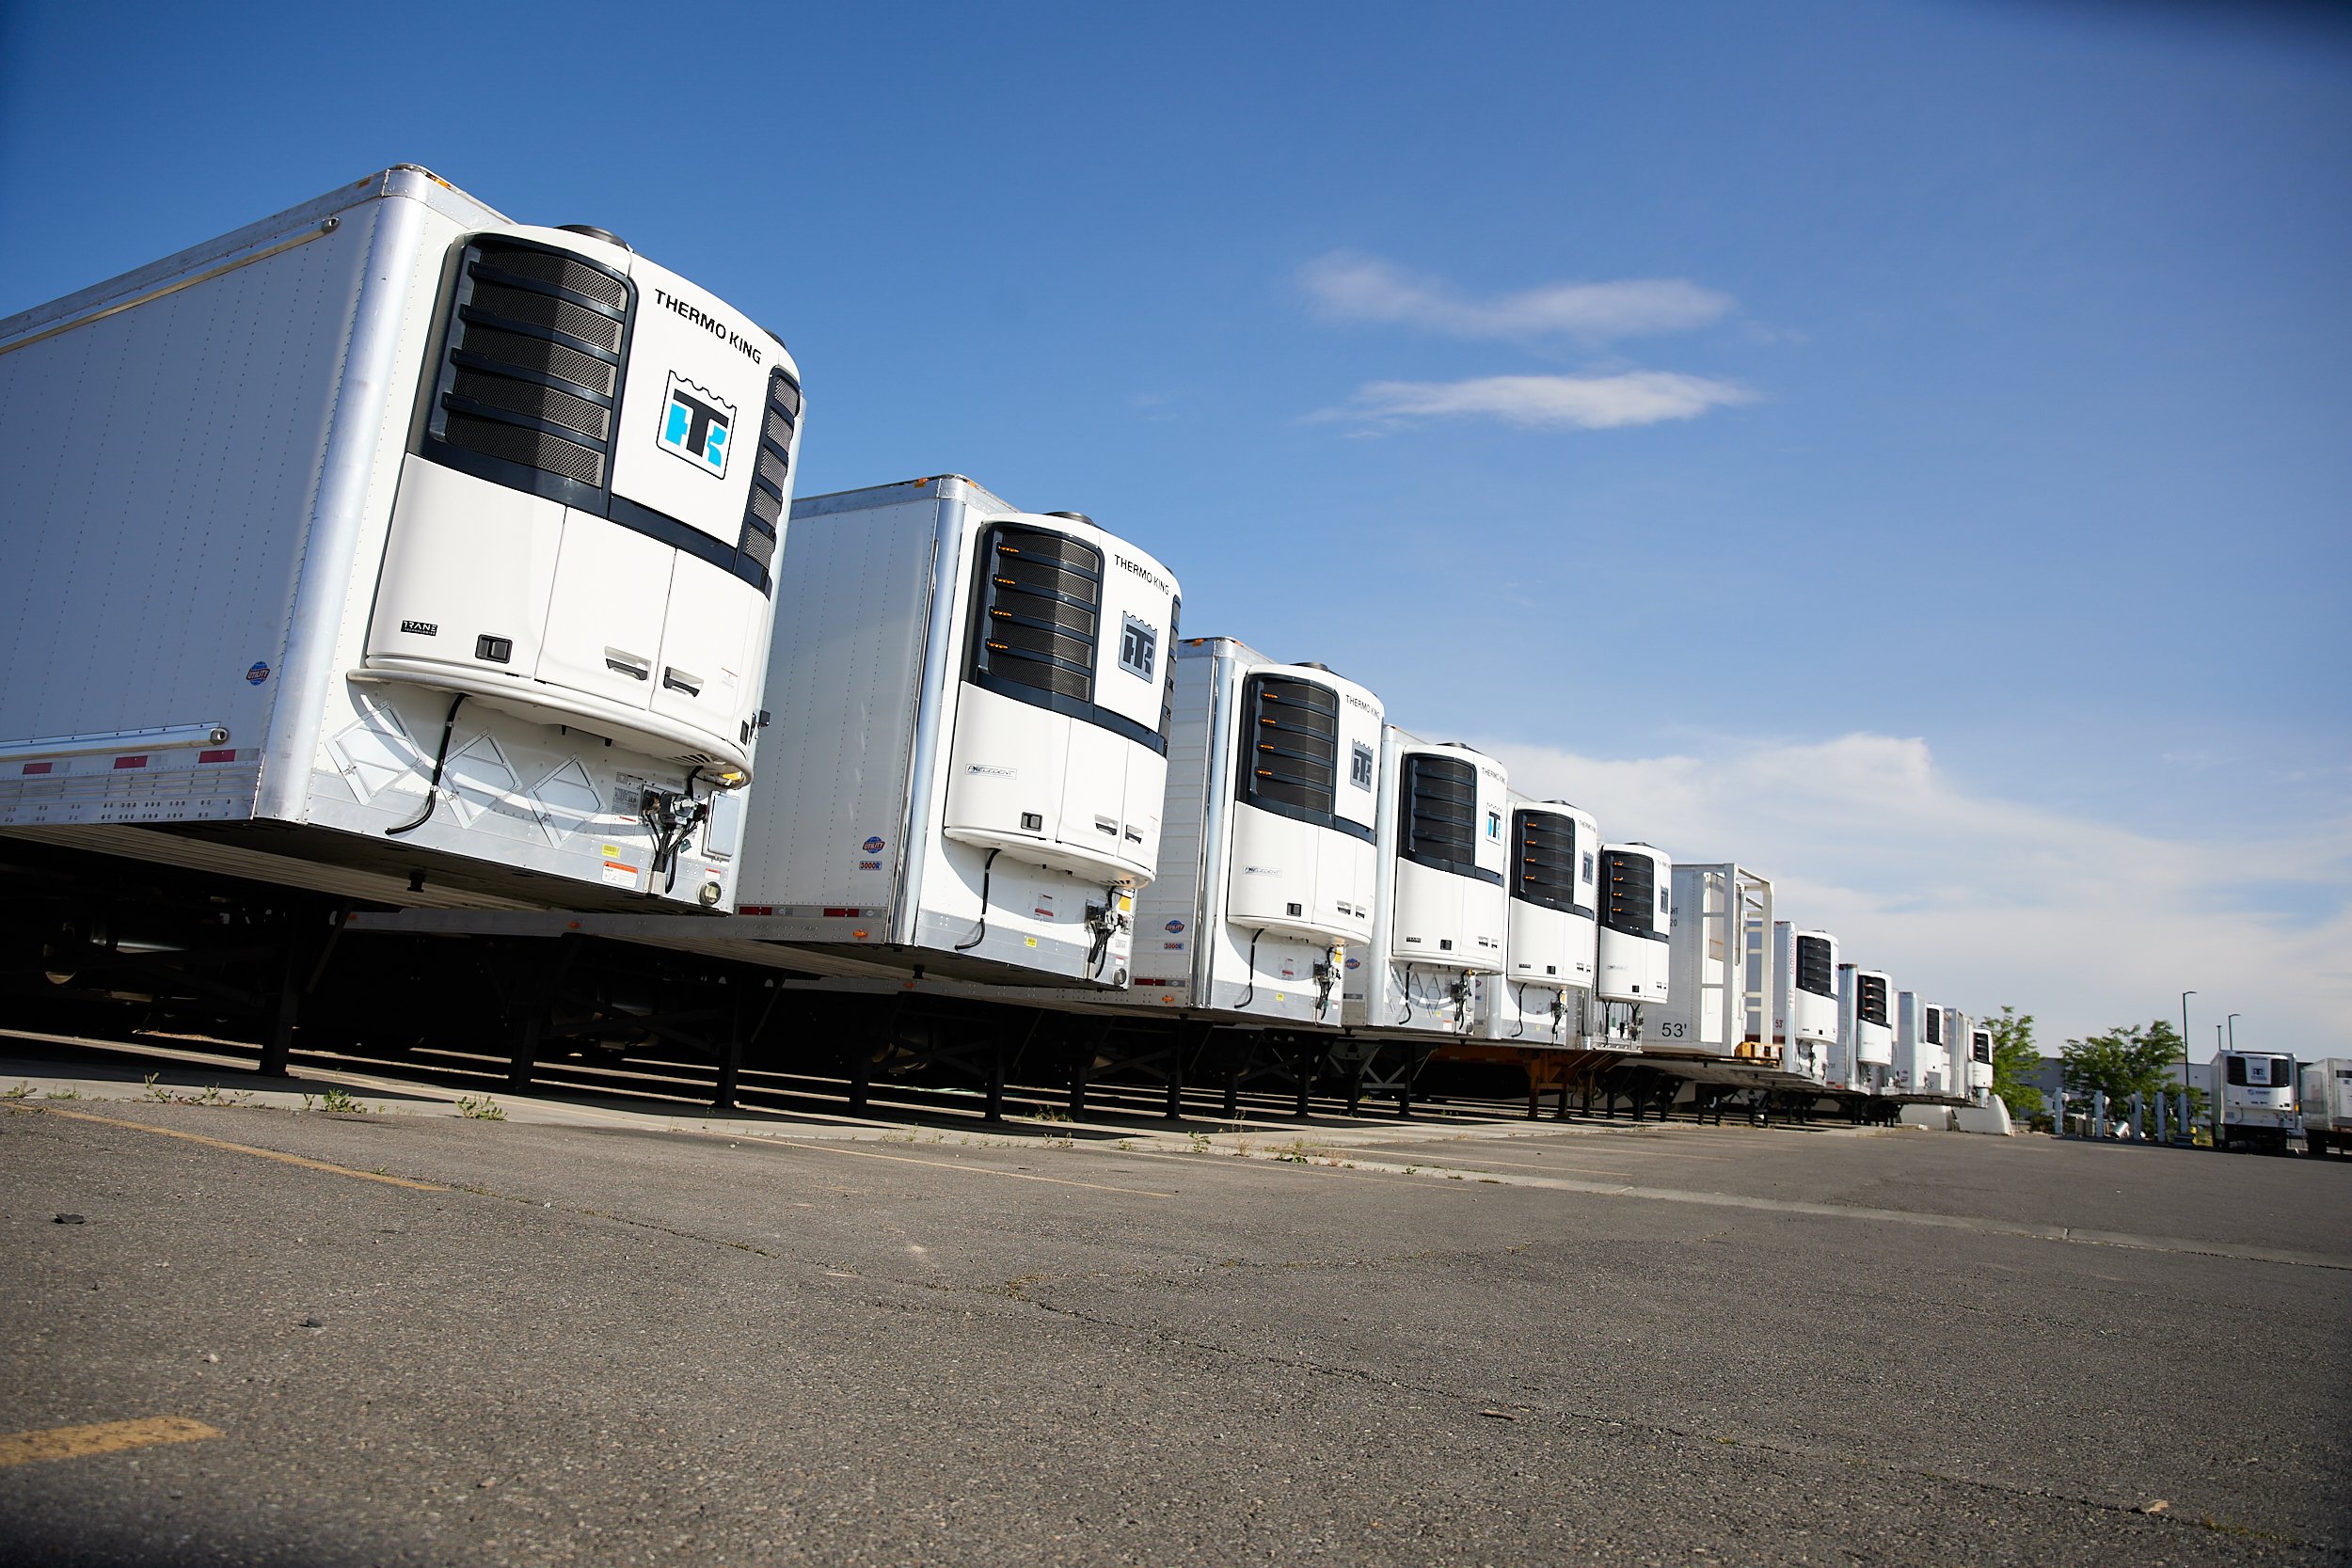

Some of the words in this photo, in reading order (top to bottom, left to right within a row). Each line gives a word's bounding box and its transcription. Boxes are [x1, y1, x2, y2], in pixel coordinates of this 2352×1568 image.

[655, 288, 726, 340] THERMO
[729, 331, 762, 365] KING
[1115, 554, 1152, 583] THERMO
[1153, 576, 1169, 595] KING
[403, 621, 437, 632] TRANE
[246, 669, 270, 679] UTILITY
[1346, 694, 1371, 713] THERMO
[863, 841, 885, 850] UTILITY
[1661, 1022, 1687, 1037] 53'
